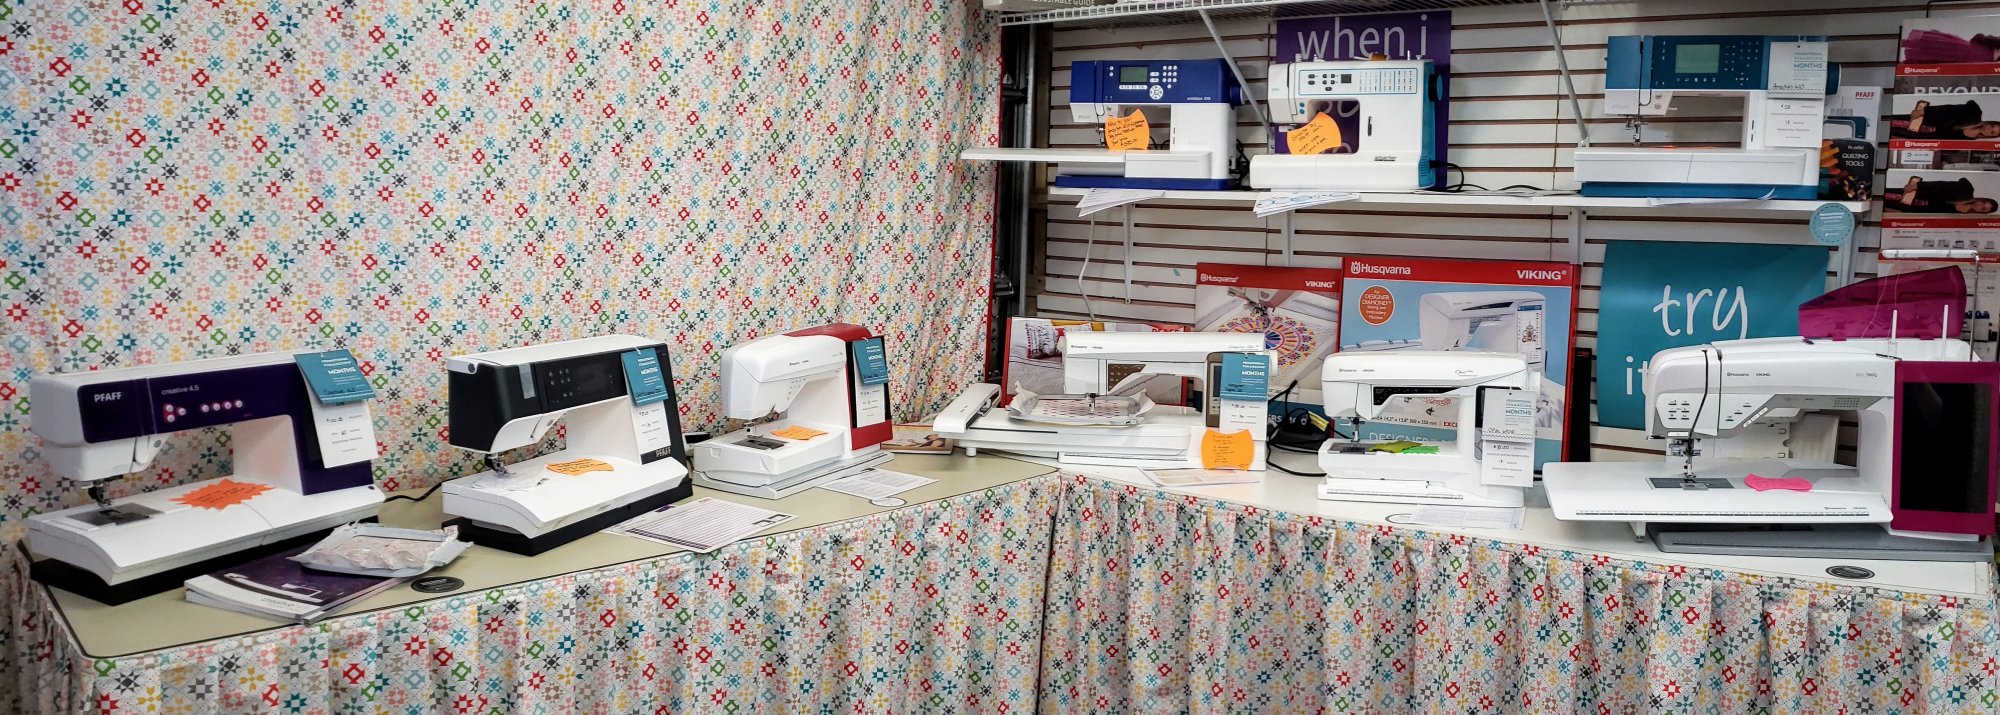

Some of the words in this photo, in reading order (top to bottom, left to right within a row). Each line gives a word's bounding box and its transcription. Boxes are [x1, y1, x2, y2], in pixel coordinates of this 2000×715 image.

[1297, 17, 1405, 60] when
[1360, 263, 1412, 275] Husqvarna
[1206, 274, 1237, 283] Husqvarna
[1653, 284, 1748, 341] try
[327, 366, 357, 375] MONTHS
[161, 387, 188, 396] creative
[189, 384, 200, 392] 4.5
[94, 391, 122, 403] PFAFF
[655, 446, 672, 458] PFAFF
